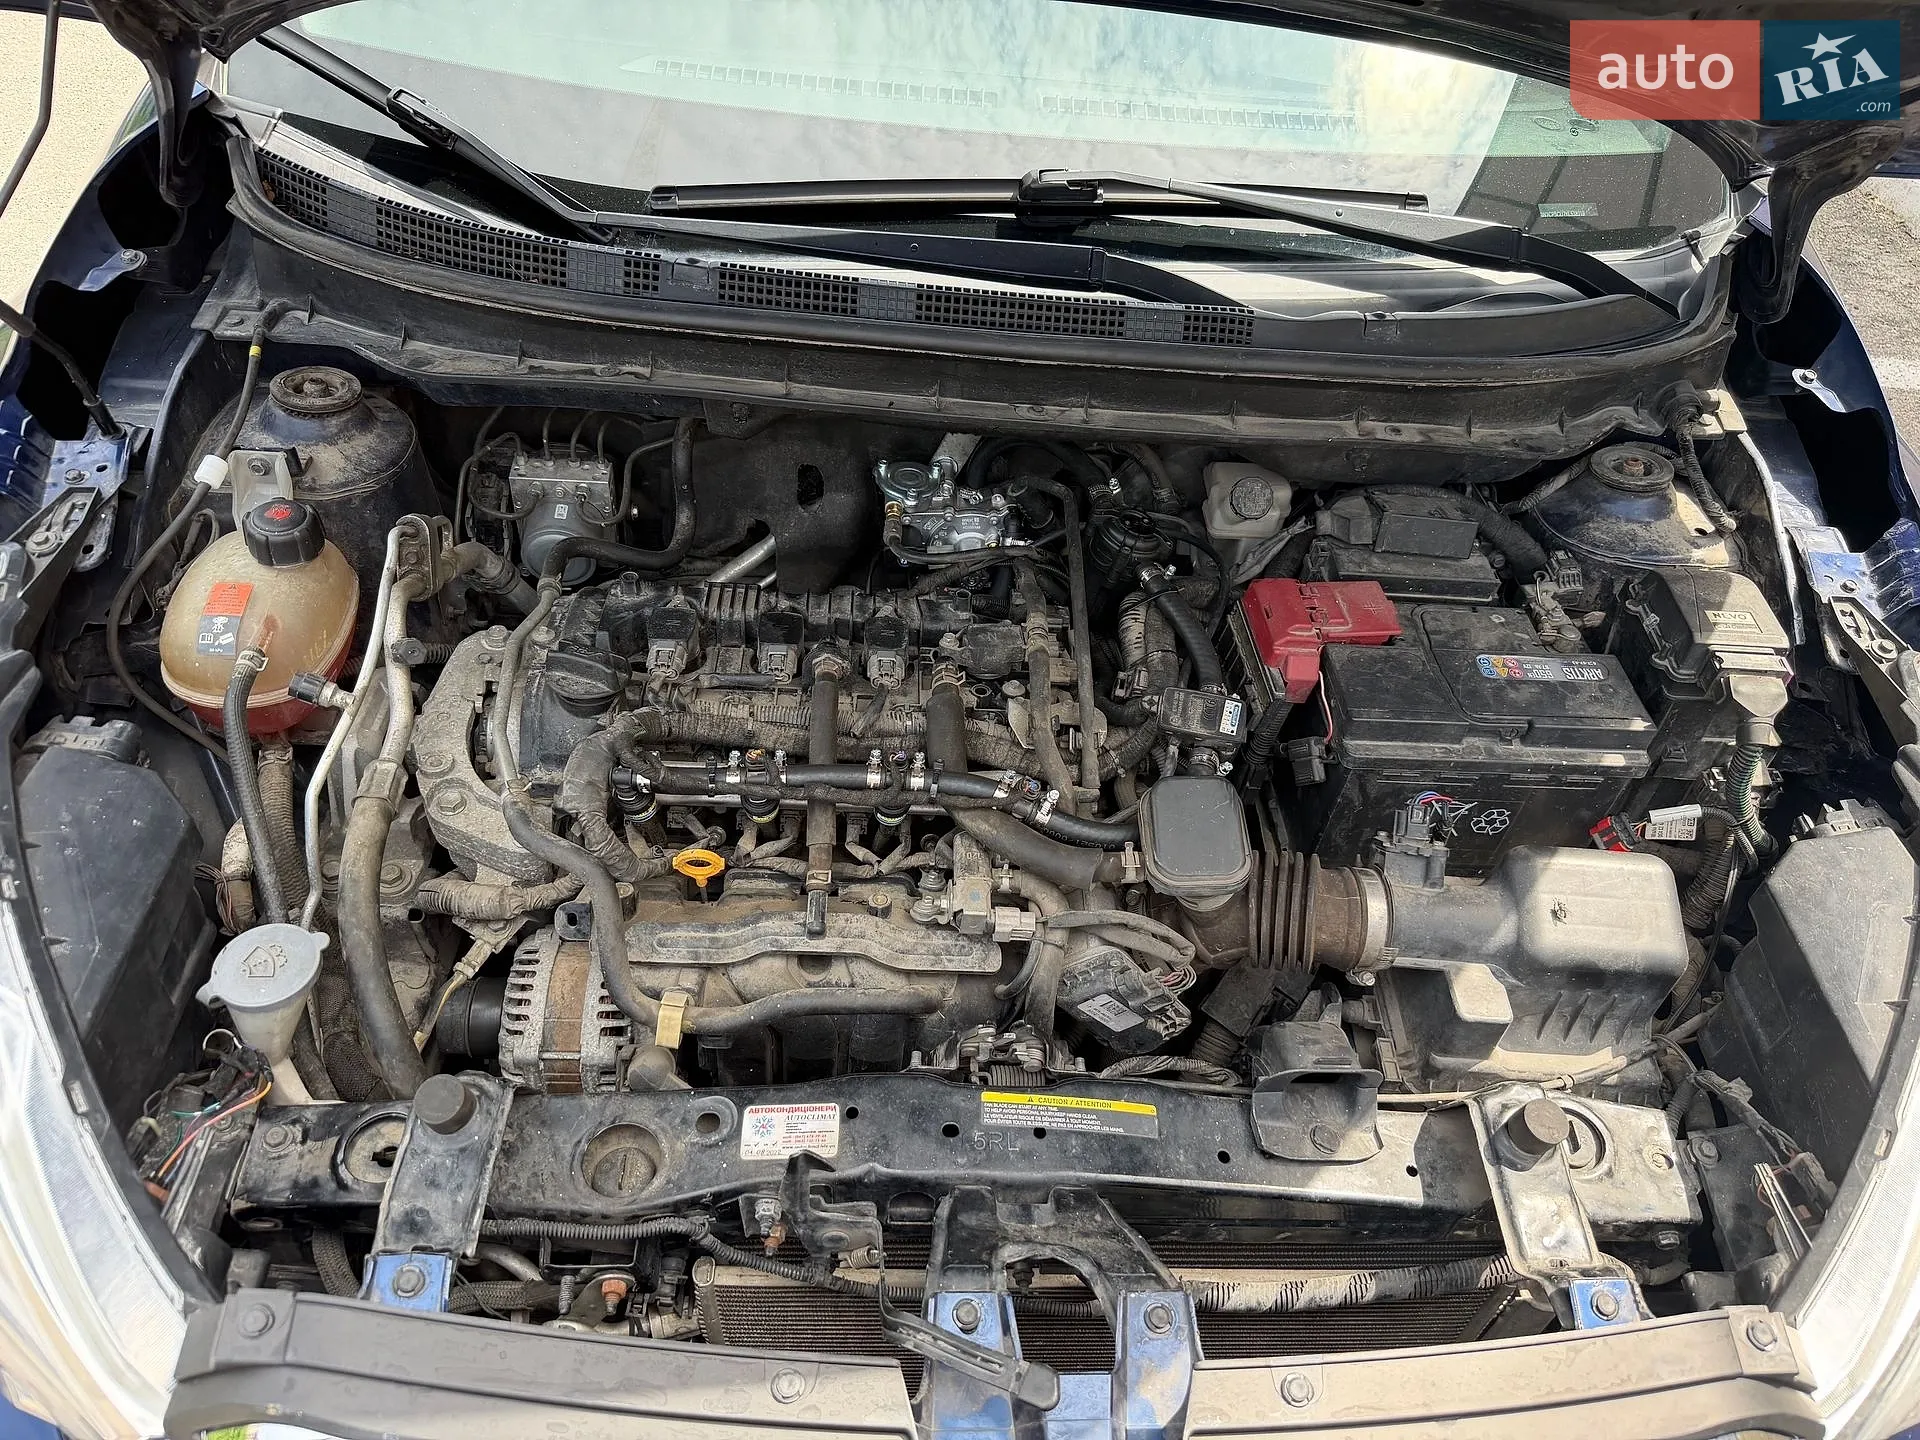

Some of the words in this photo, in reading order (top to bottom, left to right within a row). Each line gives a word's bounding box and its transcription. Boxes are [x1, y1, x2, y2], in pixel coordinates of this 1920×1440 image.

[1712, 612, 1747, 620] NEVO
[1562, 667, 1604, 680] ARKTIS
[1038, 1097, 1068, 1105] CAUTION
[1076, 1100, 1112, 1108] ATTENTION
[748, 1105, 837, 1114] АВТОКОНДИЦІОНЕРИ
[784, 1113, 836, 1121] AUTOCLIMAT
[973, 1131, 1019, 1151] 5RL
